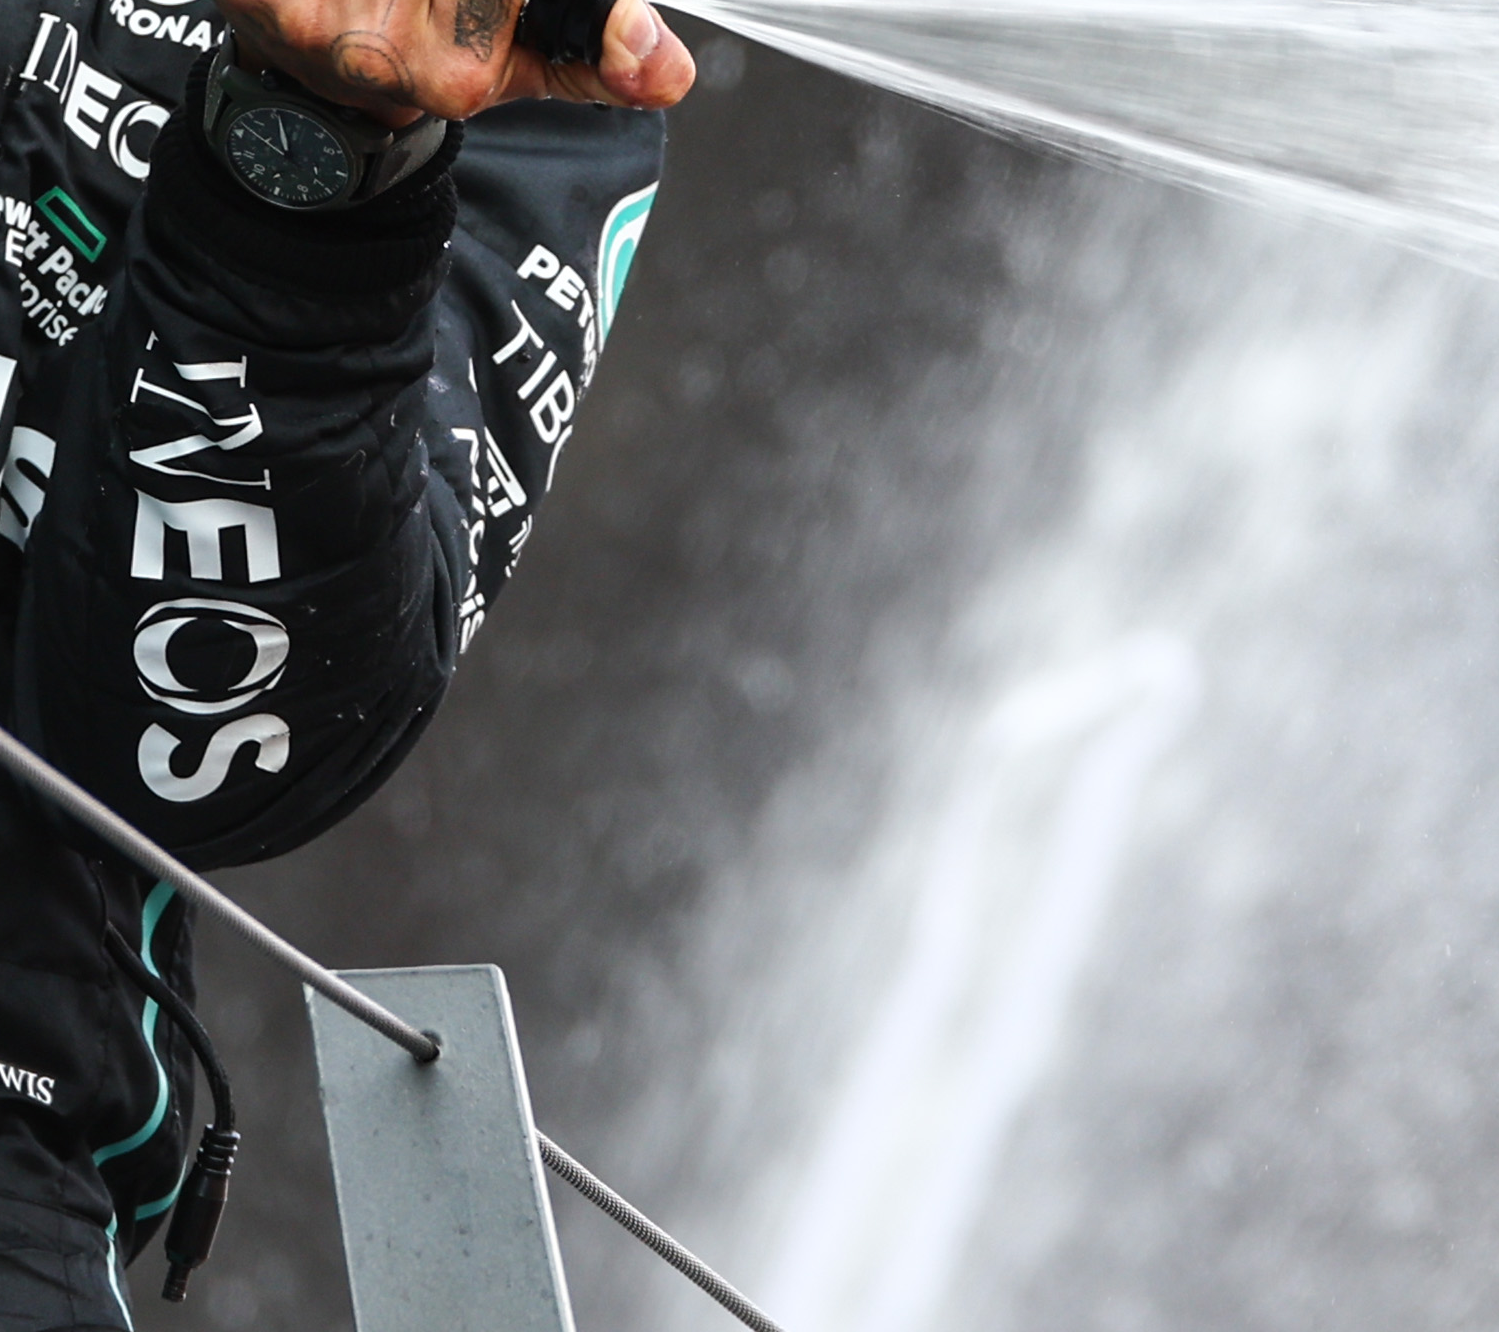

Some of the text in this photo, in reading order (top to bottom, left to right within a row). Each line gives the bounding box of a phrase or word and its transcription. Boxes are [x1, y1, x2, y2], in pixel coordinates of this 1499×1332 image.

[19, 12, 171, 180] INEO
[492, 299, 573, 492] TIB
[129, 331, 290, 803] INEOS
